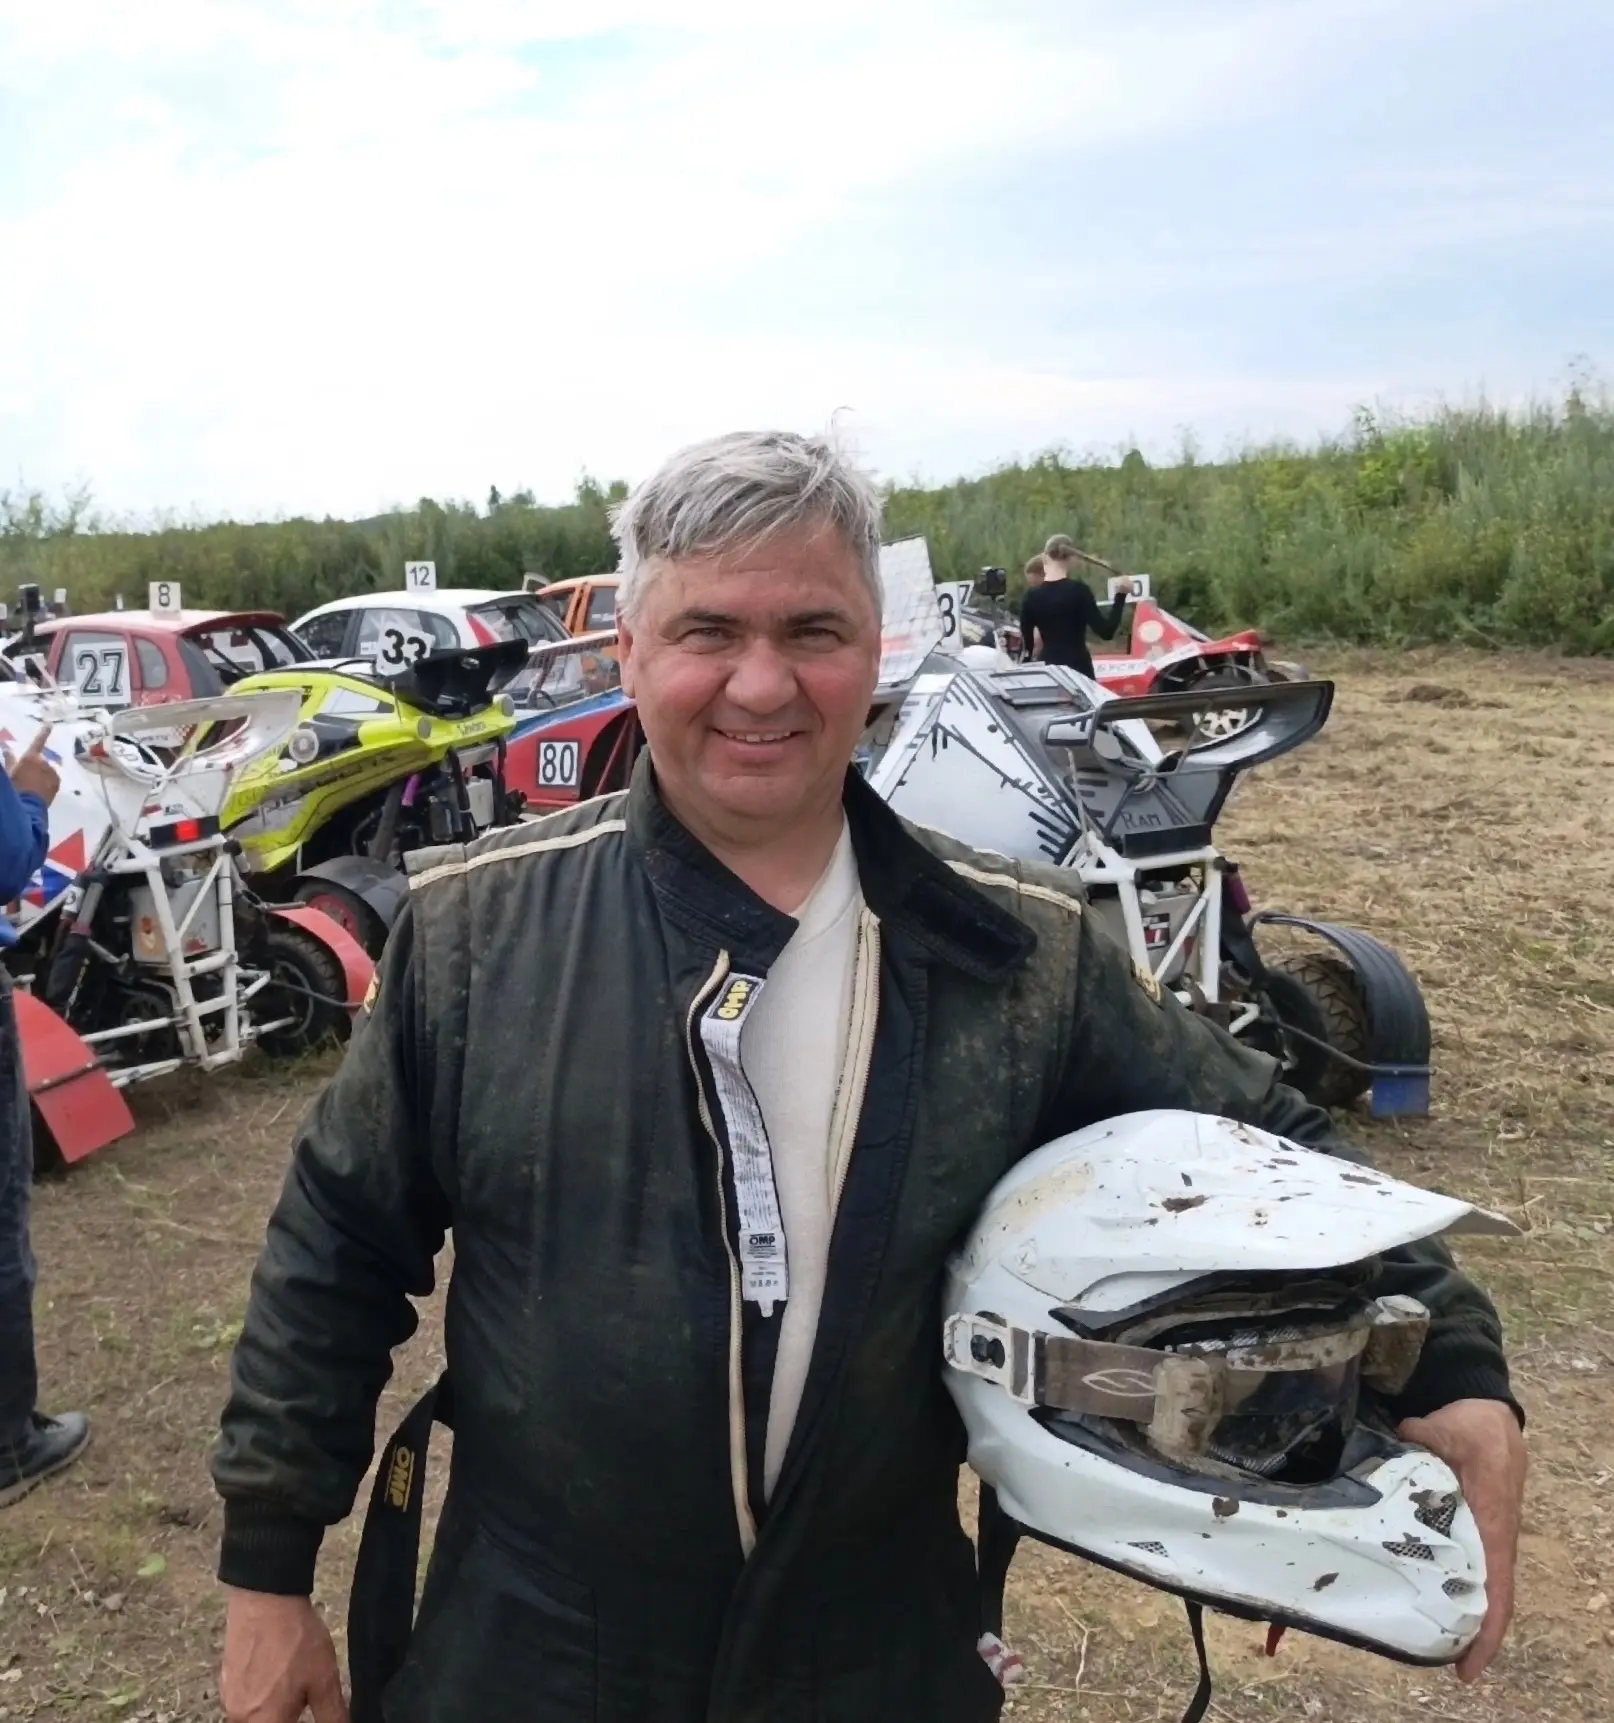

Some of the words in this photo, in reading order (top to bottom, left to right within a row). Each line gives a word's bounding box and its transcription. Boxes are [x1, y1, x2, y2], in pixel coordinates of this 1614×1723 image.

[158, 583, 171, 607] 8
[409, 566, 431, 586] 12
[77, 648, 125, 697] 27
[541, 743, 574, 783] 80
[717, 980, 752, 1019] OMP
[748, 1235, 776, 1246] OMP
[389, 1446, 411, 1507] OMP
